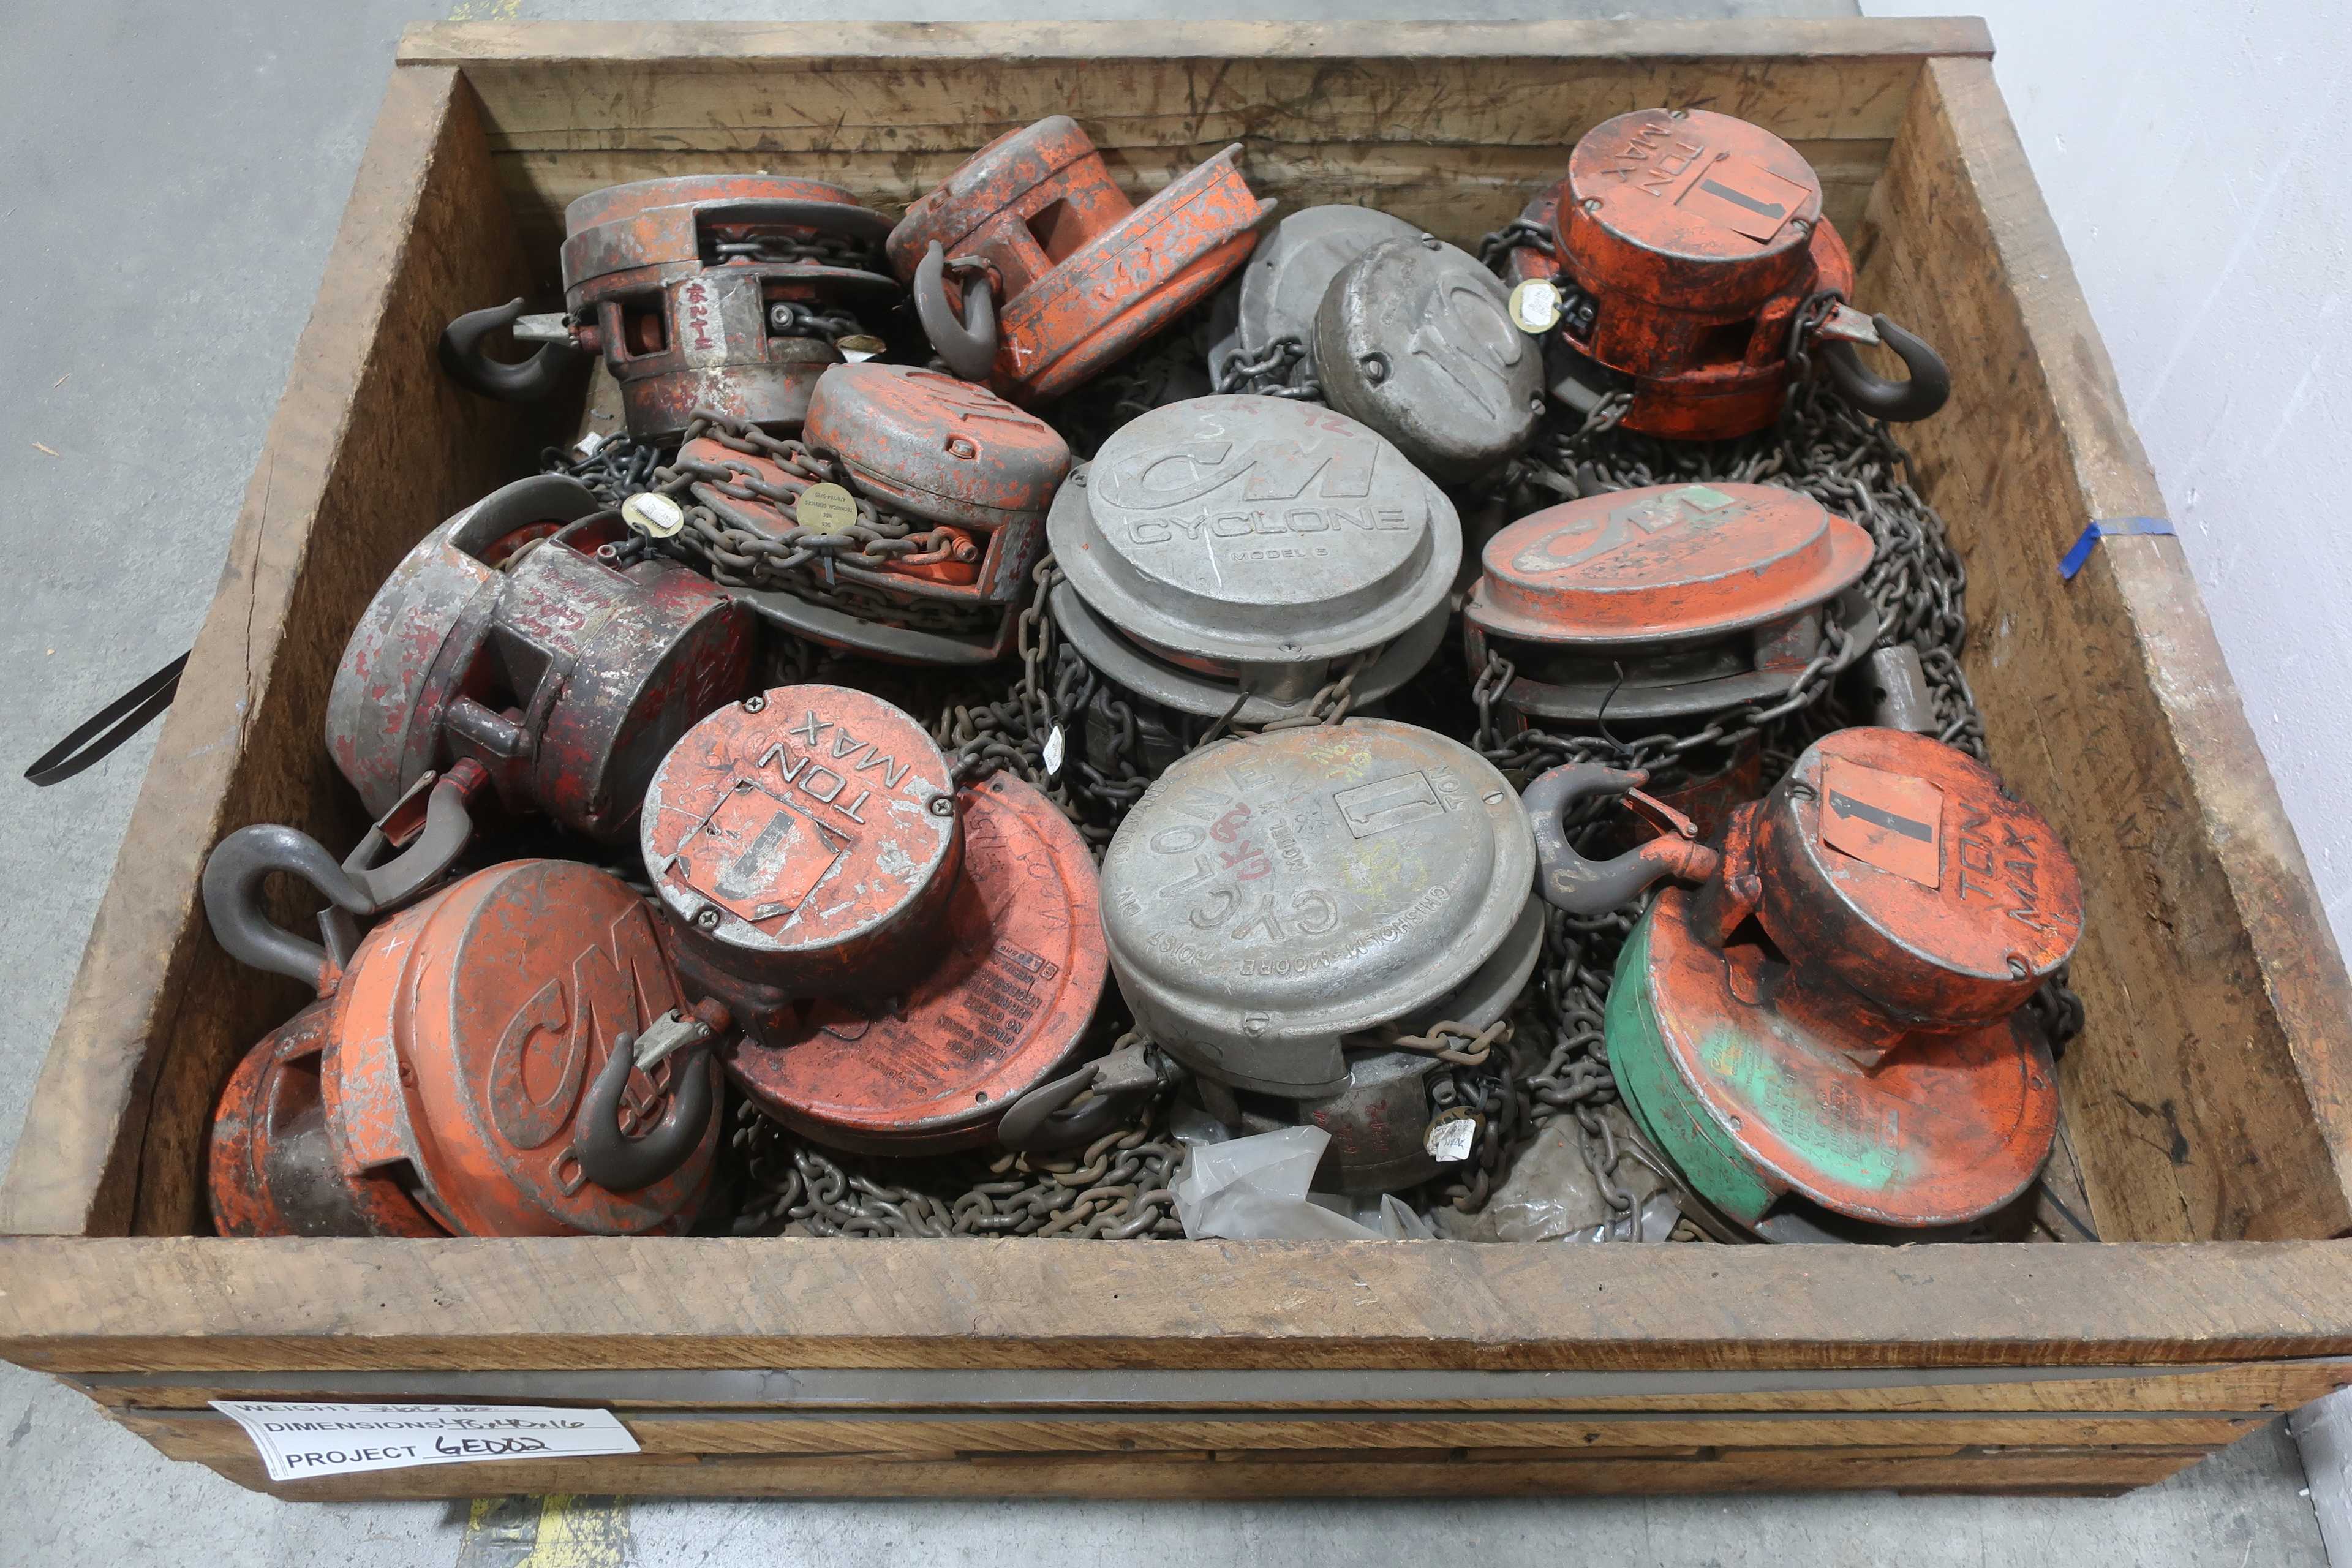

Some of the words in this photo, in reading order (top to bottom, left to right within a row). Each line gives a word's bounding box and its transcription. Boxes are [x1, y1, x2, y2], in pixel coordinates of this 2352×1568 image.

[1600, 123, 1672, 183] MAX
[1638, 141, 1705, 197] TON
[1097, 438, 1380, 510] CM
[827, 503, 853, 512] TECHNICAL
[1128, 506, 1410, 546] CYCLONE
[1510, 484, 1737, 574] CM
[1231, 548, 1303, 562] MODEL
[789, 709, 911, 789] MAX
[756, 741, 871, 824] TON
[1150, 755, 1339, 941] CYCLONE
[1269, 818, 1308, 872] MODEL
[1958, 801, 1994, 901] TON
[2002, 823, 2044, 933] MAX
[1146, 930, 1211, 964] HOIST
[964, 976, 1033, 1022] LUBRICATIO
[964, 993, 1005, 1024] OTHER
[935, 1013, 974, 1042] CHAIN
[1004, 1017, 1024, 1034] NO
[944, 1036, 979, 1063] KEEP
[973, 1035, 1006, 1060] LOAD
[235, 1404, 350, 1412] WEIGHT
[263, 1421, 448, 1433] DIMENSIONS
[287, 1445, 417, 1469] PROJECT
